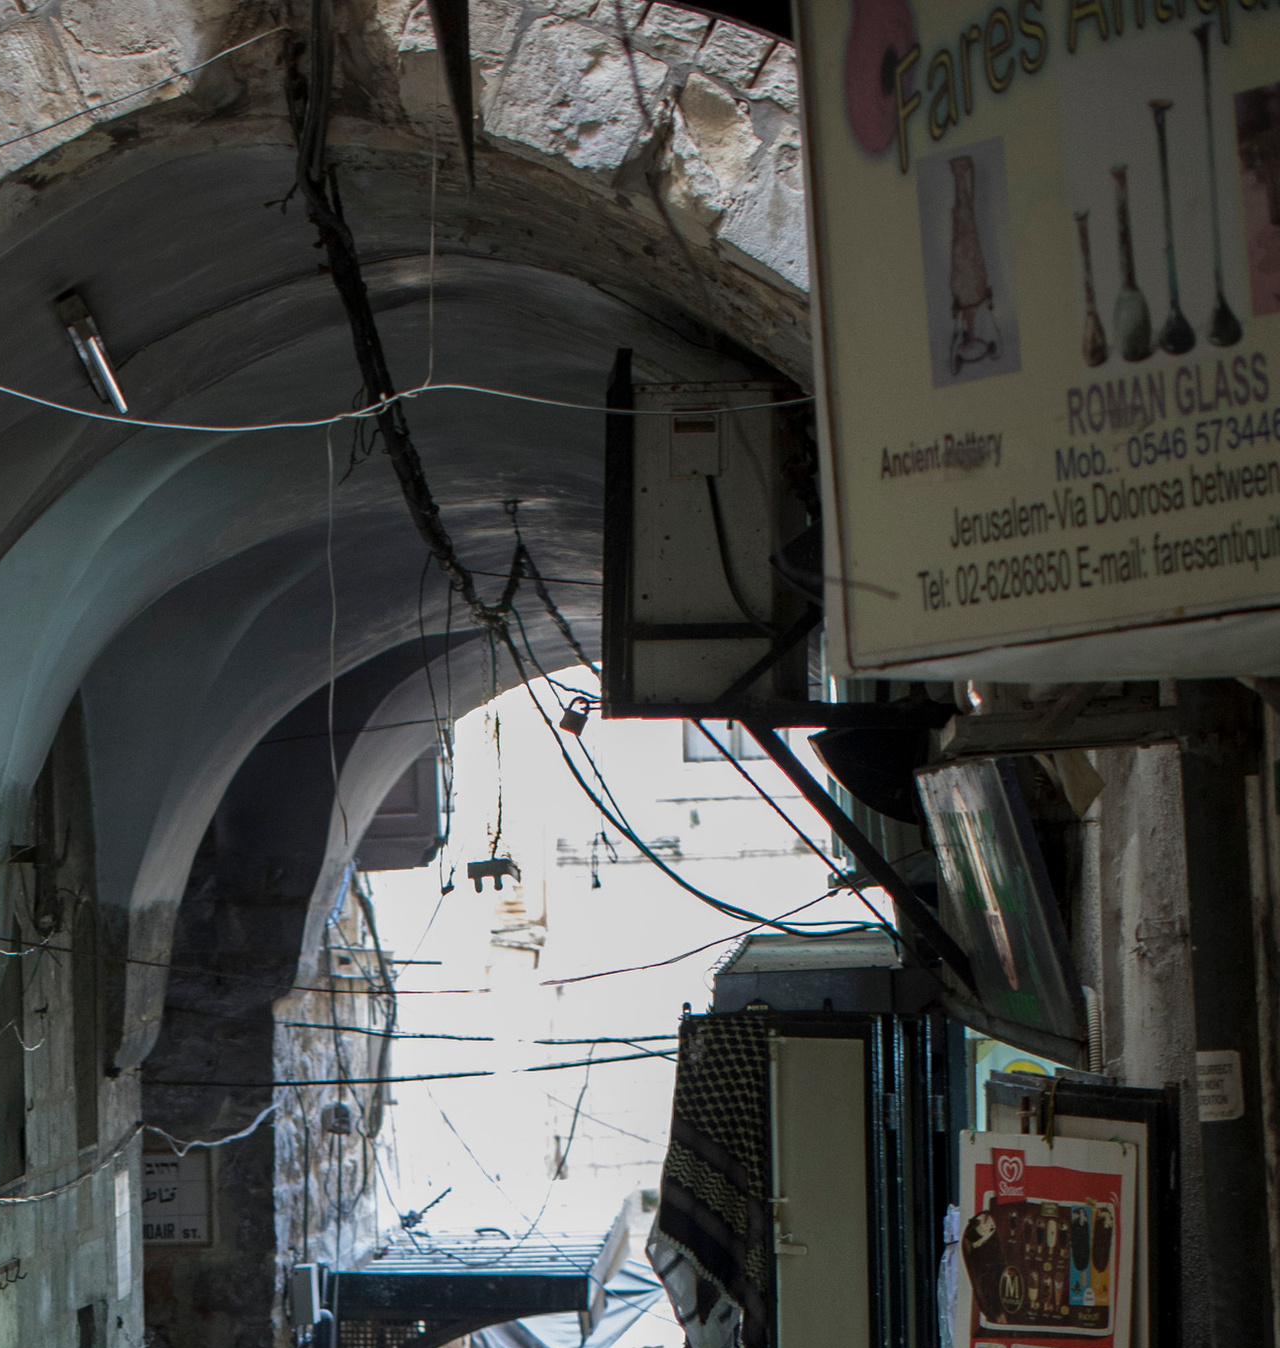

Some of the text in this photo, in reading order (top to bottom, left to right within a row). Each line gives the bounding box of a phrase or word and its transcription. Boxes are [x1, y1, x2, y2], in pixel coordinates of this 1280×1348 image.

[894, 0, 1048, 175] Fares
[1067, 351, 1270, 436] ROMAN GLASS
[880, 439, 941, 479] Ancient
[1128, 427, 1187, 468] 0546
[950, 460, 1280, 548] Jerusalem-Via Dolorosa between
[918, 568, 951, 611] Tel:
[956, 549, 1072, 606] 02-6286850
[1077, 537, 1148, 588] E-mail:
